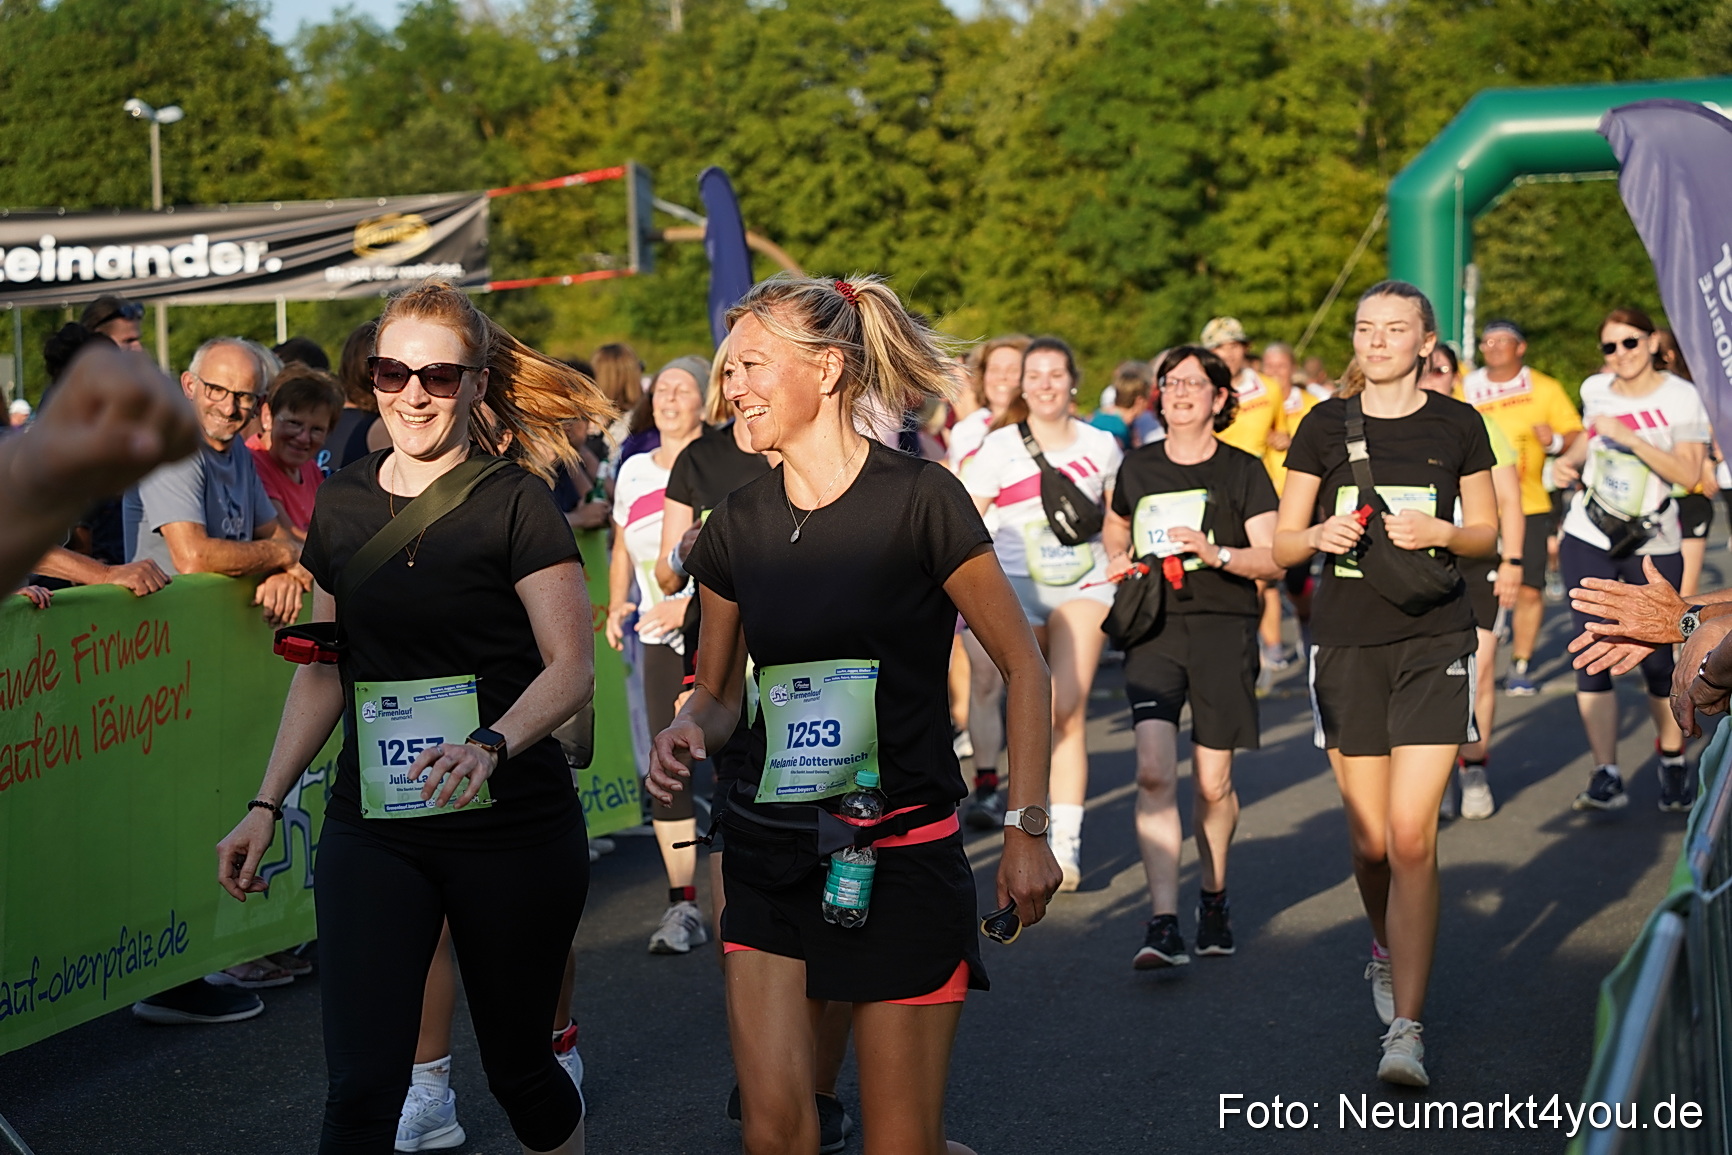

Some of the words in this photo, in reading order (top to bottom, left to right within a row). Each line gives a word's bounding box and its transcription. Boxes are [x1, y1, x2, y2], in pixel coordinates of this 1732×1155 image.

[0, 234, 283, 283] einander.
[1147, 528, 1166, 545] 12
[0, 633, 61, 711] nde
[71, 619, 171, 685] Firmen
[789, 688, 822, 701] Firmenlauf
[377, 707, 413, 718] Firmenlauf
[0, 711, 82, 792] aufen
[92, 659, 193, 756] länger!
[786, 719, 841, 750] 1253
[769, 756, 798, 770] Melanie
[798, 752, 868, 767] Dotterweich
[389, 773, 414, 785] Julia
